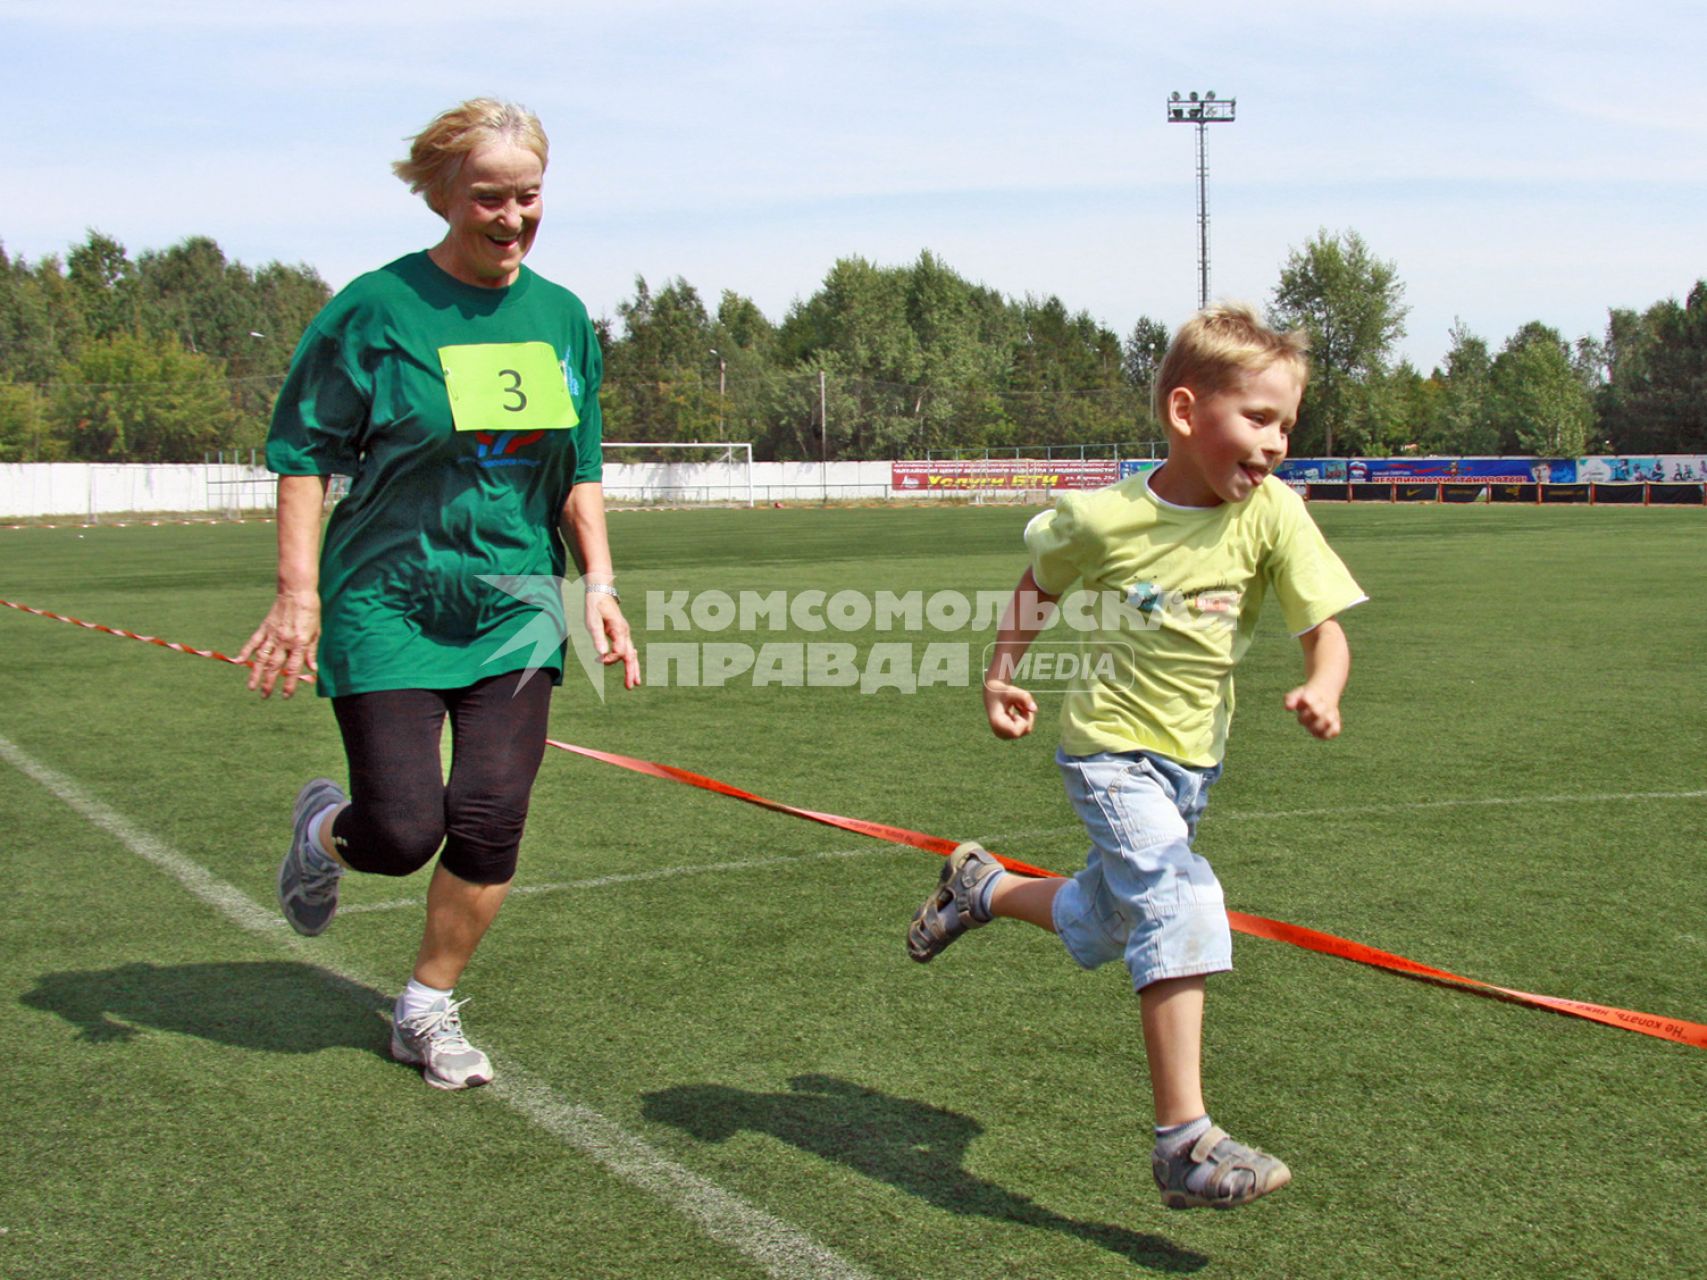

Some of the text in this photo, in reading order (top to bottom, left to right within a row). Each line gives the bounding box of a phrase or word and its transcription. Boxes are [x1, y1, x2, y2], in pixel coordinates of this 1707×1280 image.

[498, 368, 528, 412] 3
[927, 475, 1005, 490] Услуги
[1010, 474, 1060, 487] БТИ
